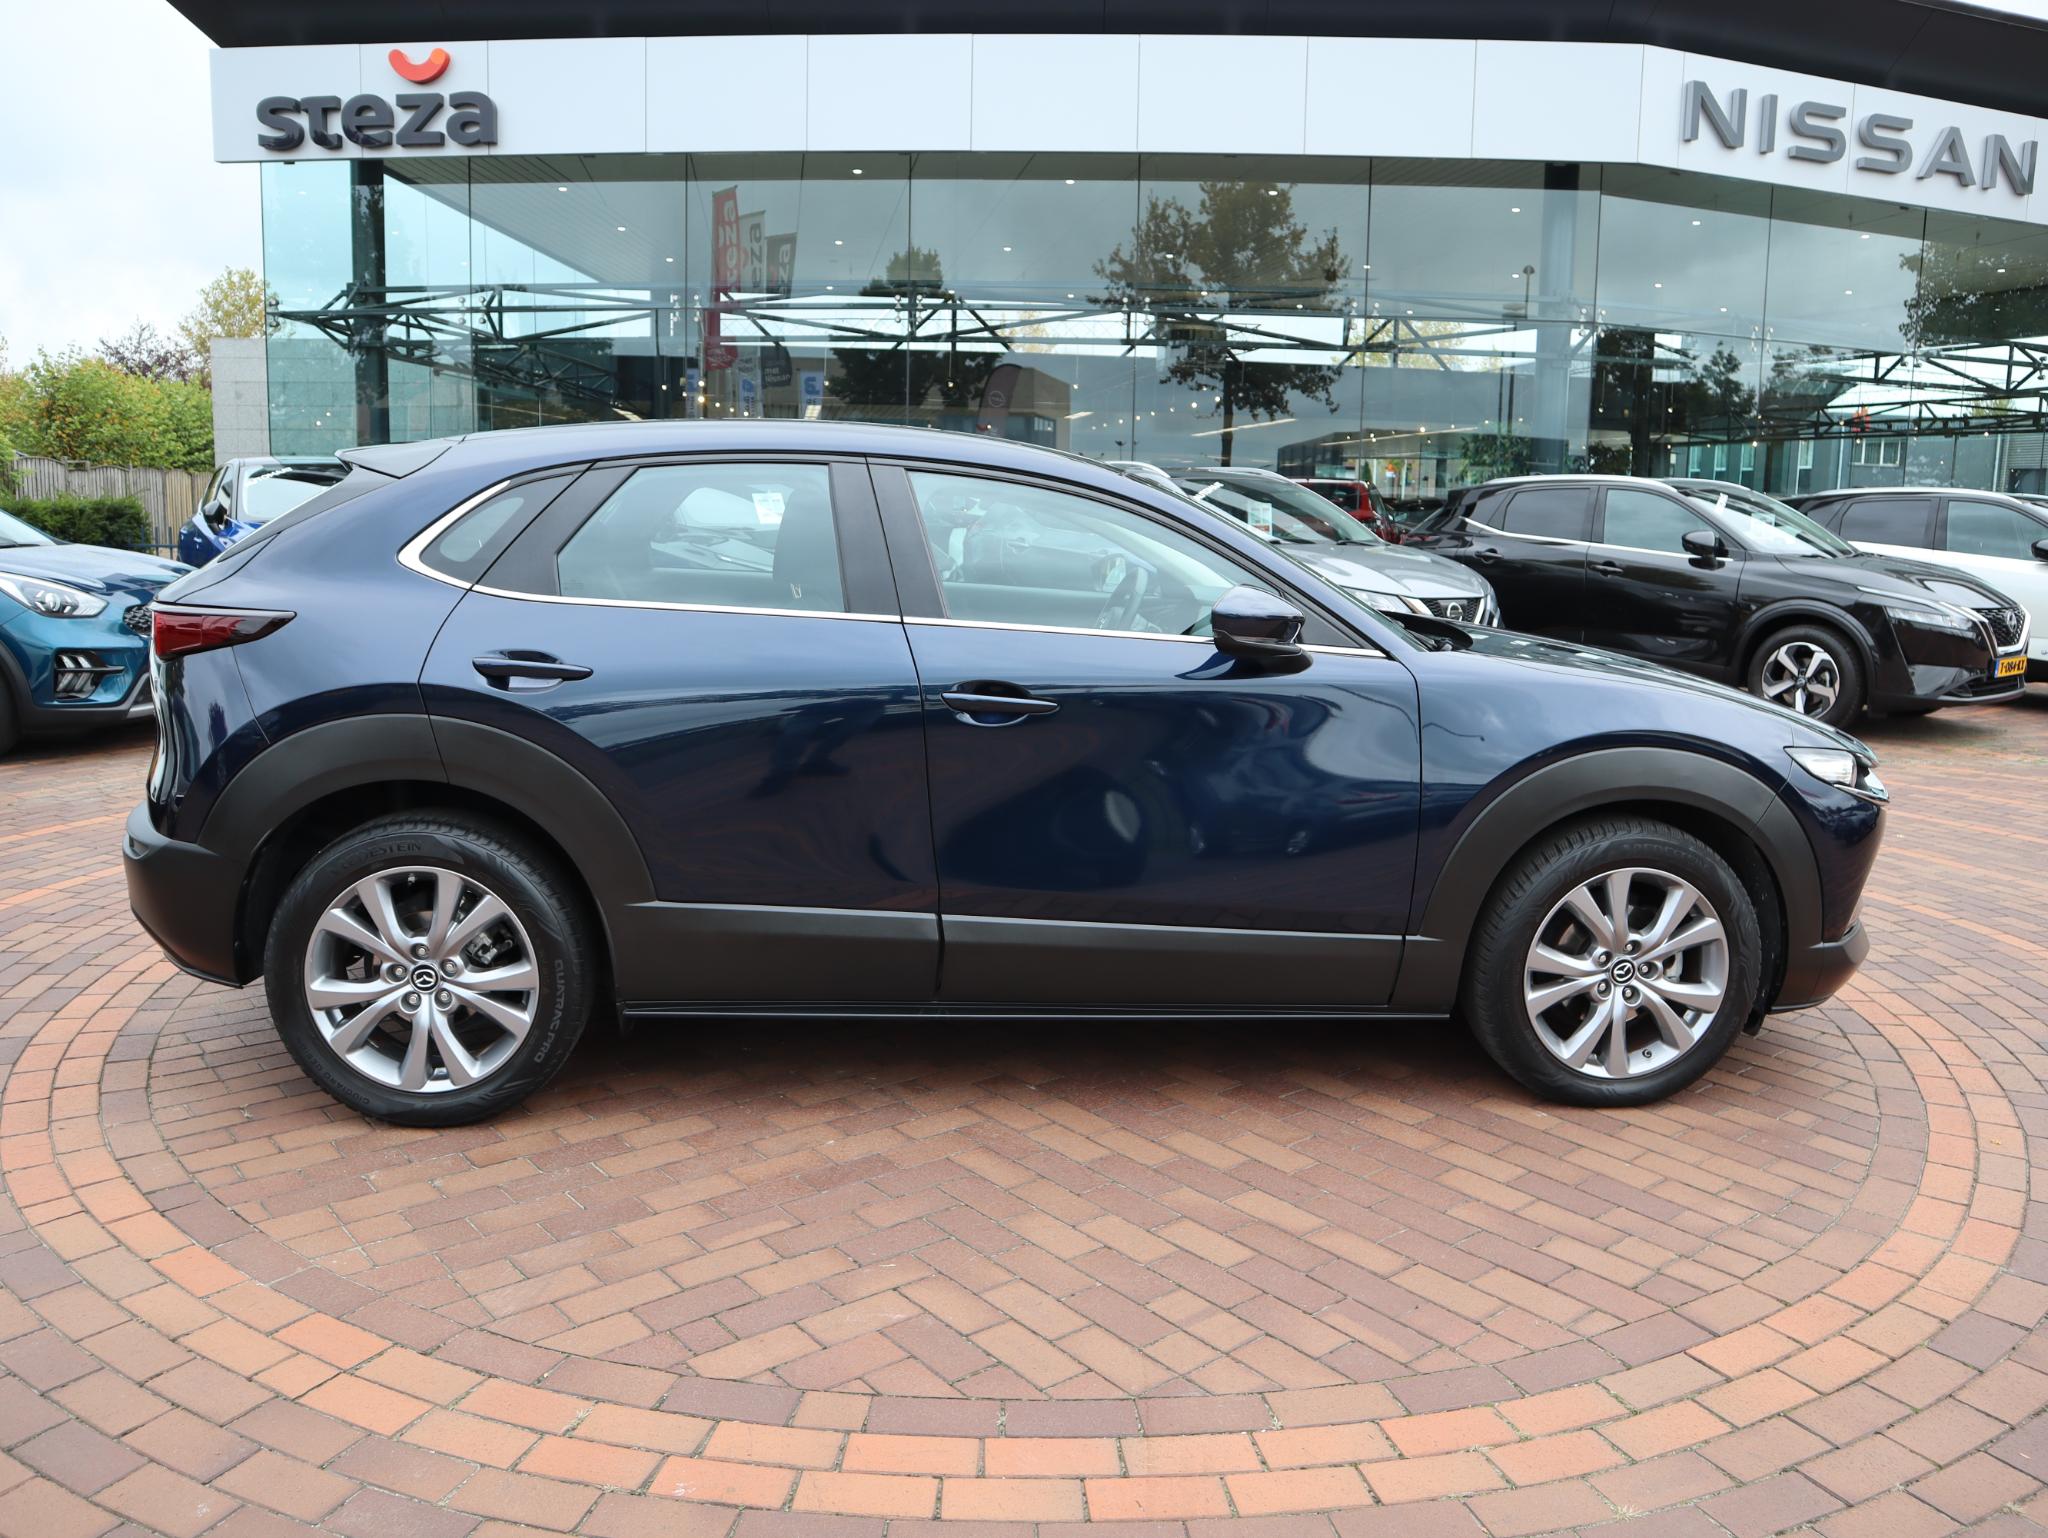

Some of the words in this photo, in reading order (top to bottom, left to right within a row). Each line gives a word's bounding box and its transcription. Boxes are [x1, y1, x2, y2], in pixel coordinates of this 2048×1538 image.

[256, 91, 498, 151] steza
[1683, 80, 2038, 196] NISSAN
[550, 960, 566, 1031] QUATRAC
[534, 1032, 556, 1063] PRO
